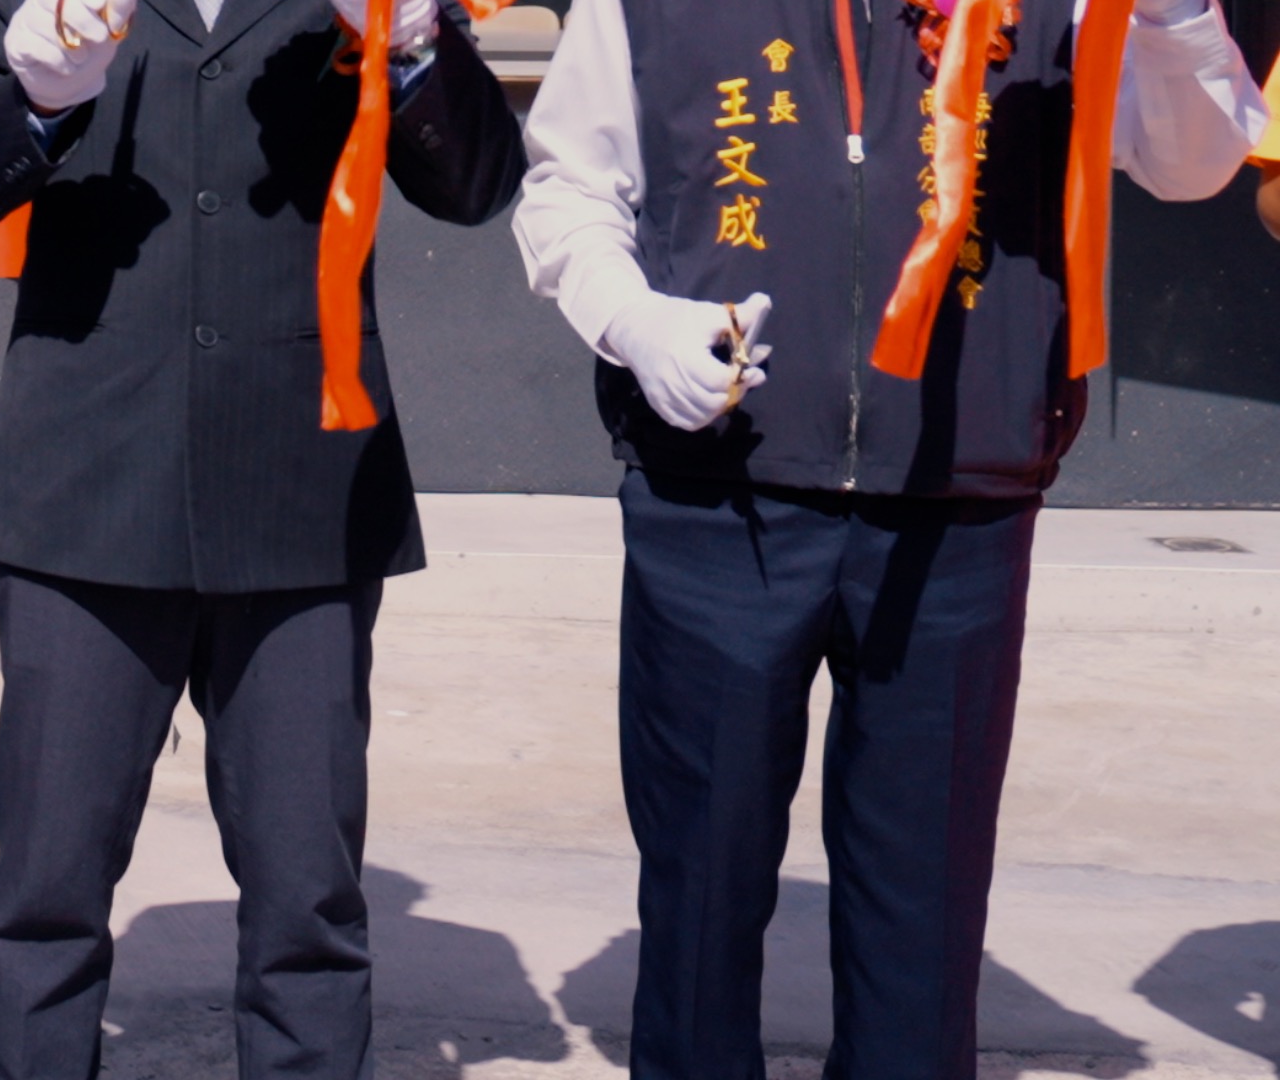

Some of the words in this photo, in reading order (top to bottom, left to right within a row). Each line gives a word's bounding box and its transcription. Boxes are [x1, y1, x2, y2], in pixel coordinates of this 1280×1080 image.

[762, 38, 799, 124] 會長
[714, 77, 768, 250] 王文成
